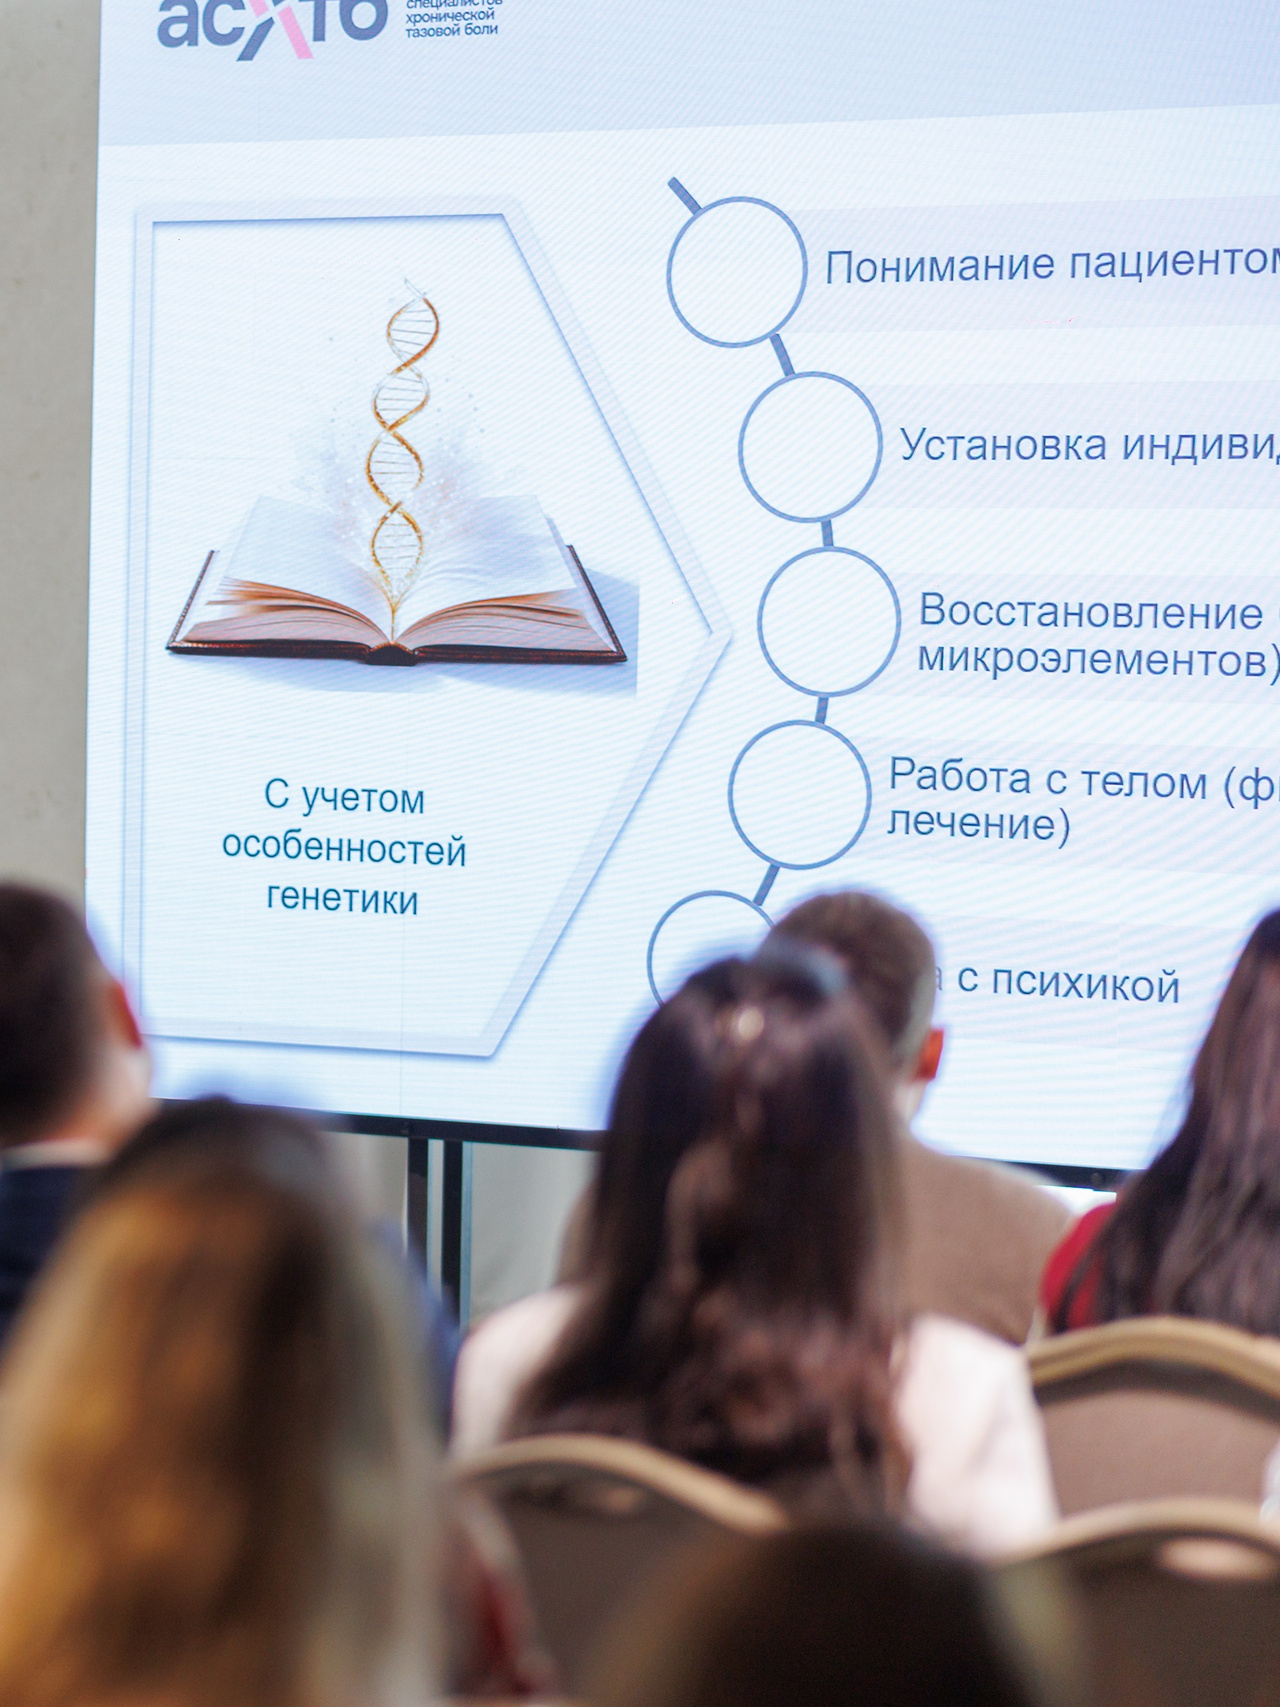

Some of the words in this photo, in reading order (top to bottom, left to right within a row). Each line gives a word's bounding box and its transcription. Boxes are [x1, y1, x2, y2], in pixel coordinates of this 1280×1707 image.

[406, 7, 495, 26] хронической
[406, 23, 461, 38] тазовой
[464, 22, 498, 36] боли
[826, 249, 1055, 284] Понимание
[899, 427, 1107, 461] Установка
[1122, 433, 1280, 466] индиви
[920, 591, 1263, 630] Восстановление
[918, 642, 1280, 687] микроэлементов)
[264, 777, 290, 809] С
[301, 785, 425, 818] учетом
[890, 755, 1031, 795] Работа
[1045, 769, 1068, 796] с
[1080, 770, 1207, 800] телом
[1223, 765, 1280, 810] (ф
[222, 827, 467, 867] особенностей
[886, 807, 1071, 850] лечение)
[267, 885, 419, 915] генетики
[957, 966, 979, 993] с
[993, 968, 1180, 1004] психикой
